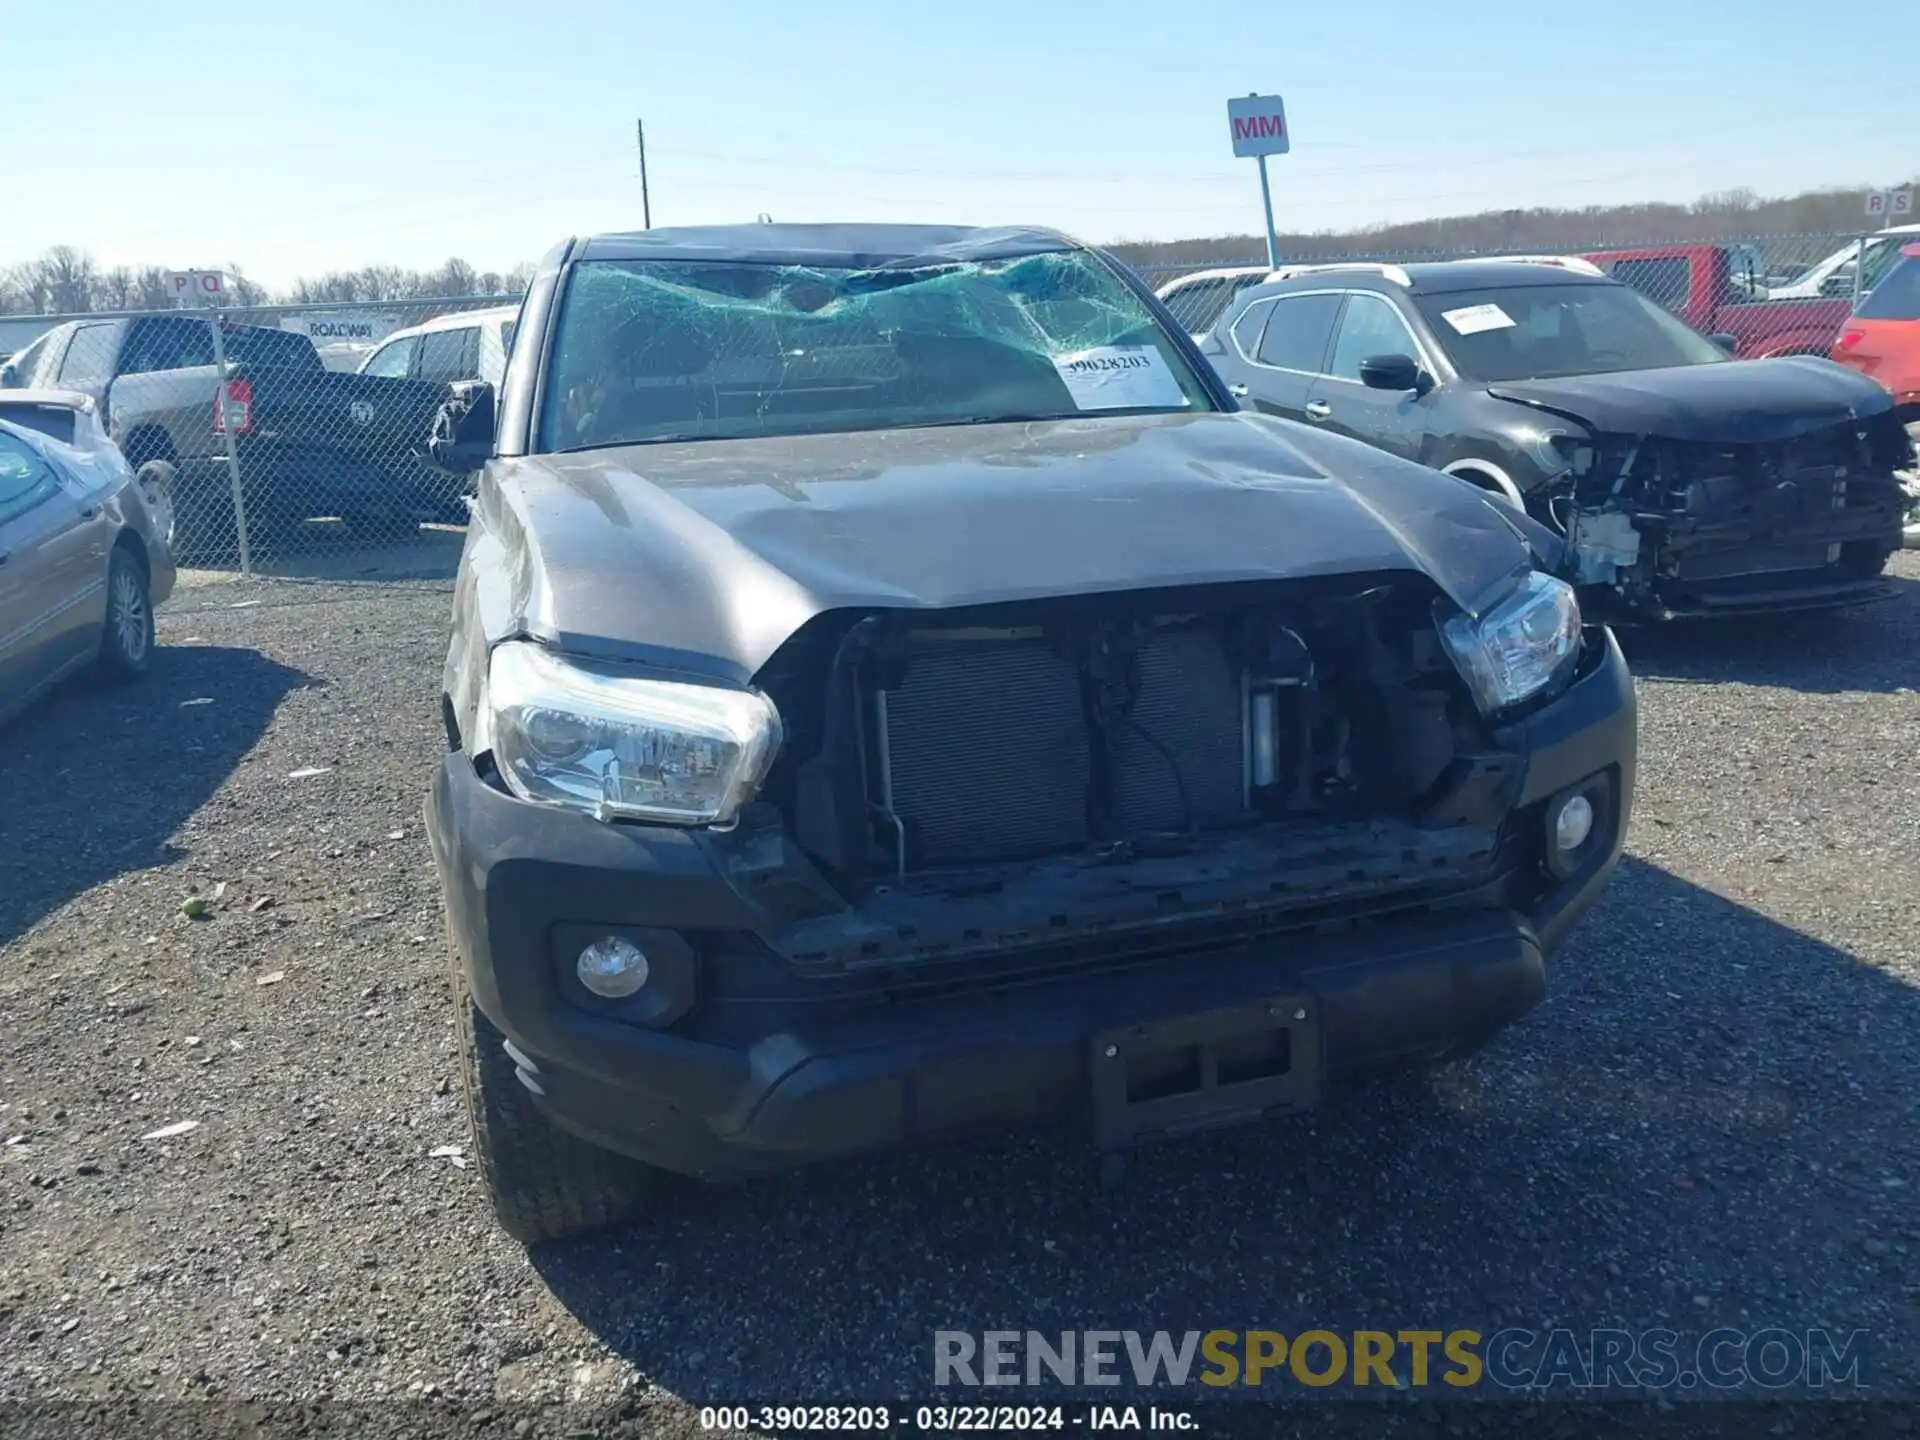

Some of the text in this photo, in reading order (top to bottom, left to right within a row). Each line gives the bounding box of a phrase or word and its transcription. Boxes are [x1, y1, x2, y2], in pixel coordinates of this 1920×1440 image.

[1233, 114, 1283, 140] MM
[1869, 195, 1881, 212] R
[1895, 194, 1907, 211] S
[175, 276, 187, 292] P
[202, 274, 220, 292] Q
